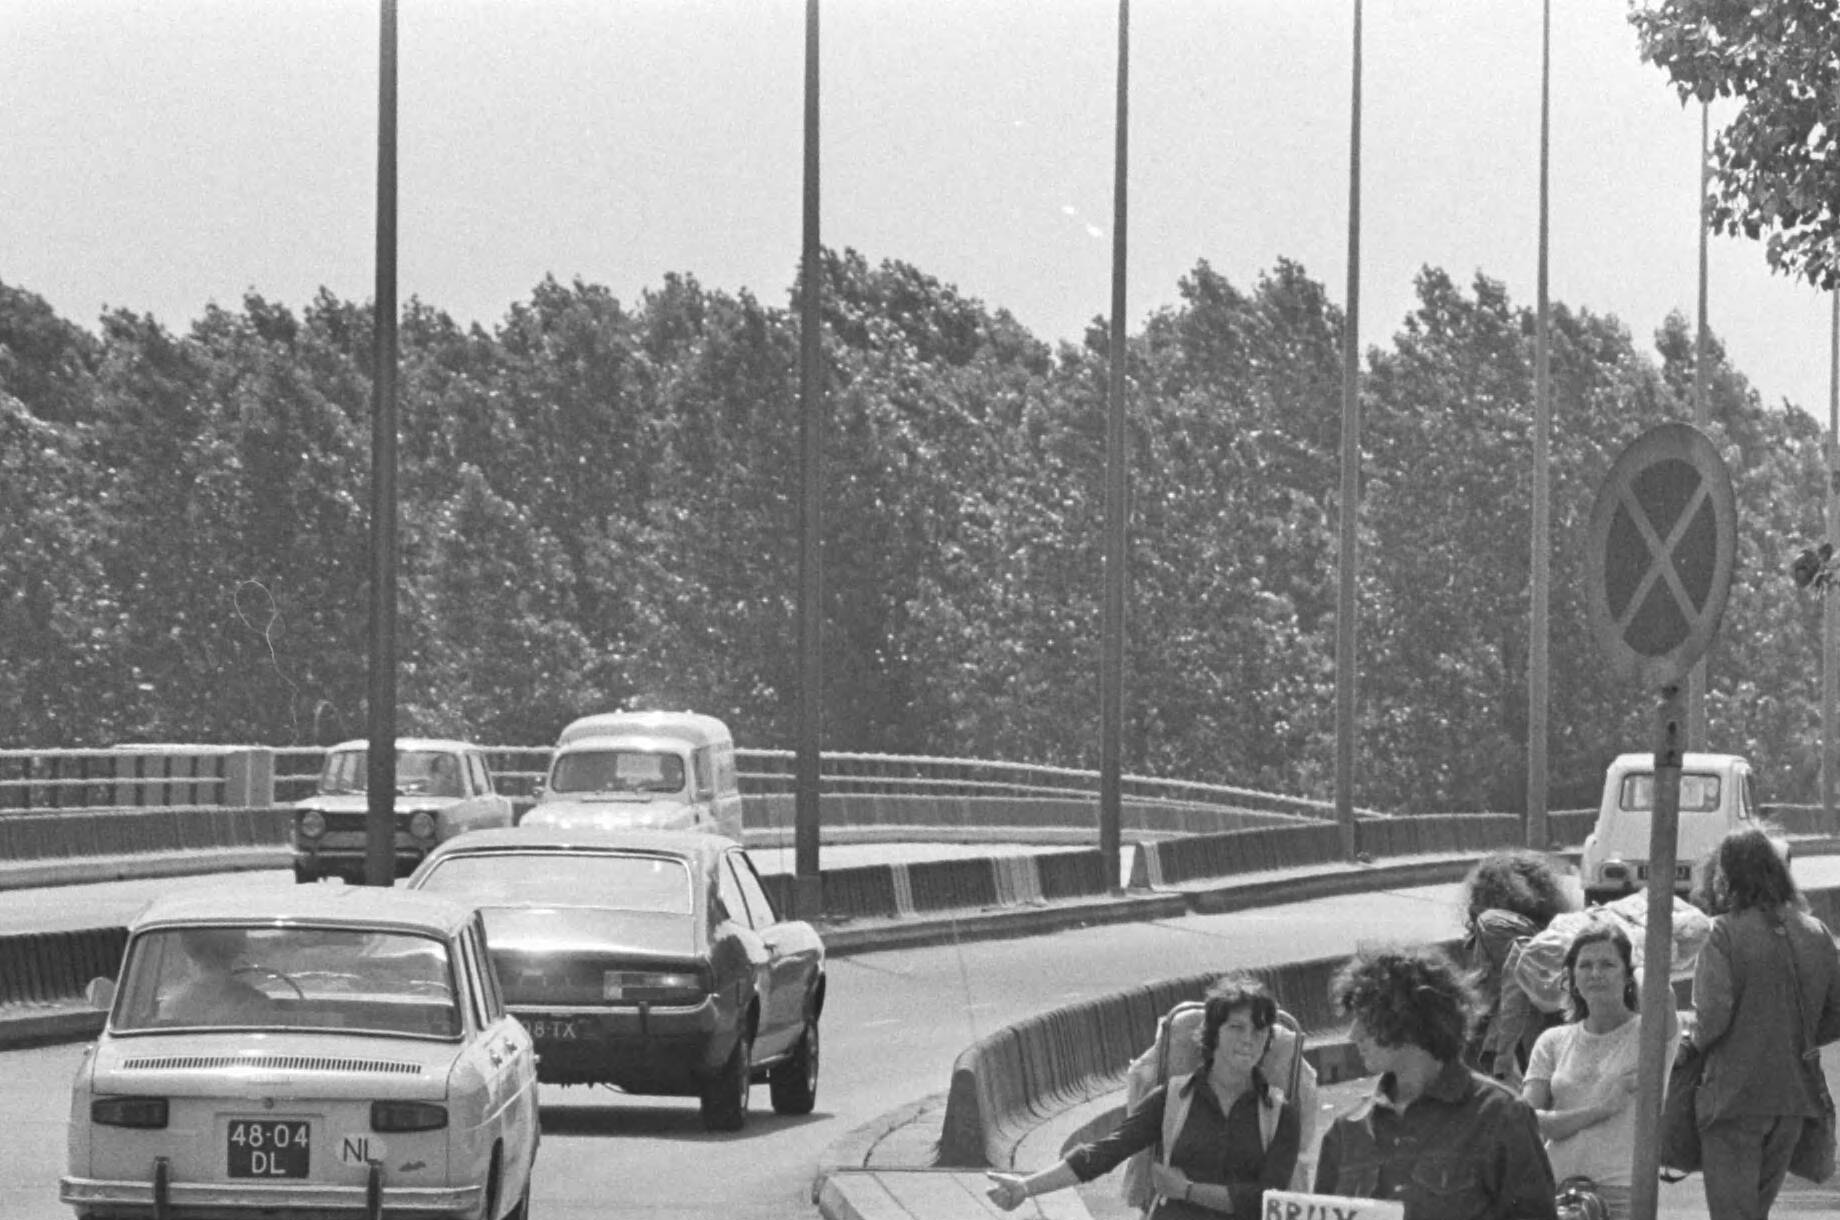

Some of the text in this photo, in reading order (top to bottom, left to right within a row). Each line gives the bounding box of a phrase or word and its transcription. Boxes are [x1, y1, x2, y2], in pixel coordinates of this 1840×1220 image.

[231, 1124, 308, 1148] 48-04
[343, 1137, 378, 1164] NL
[252, 1151, 286, 1175] DL
